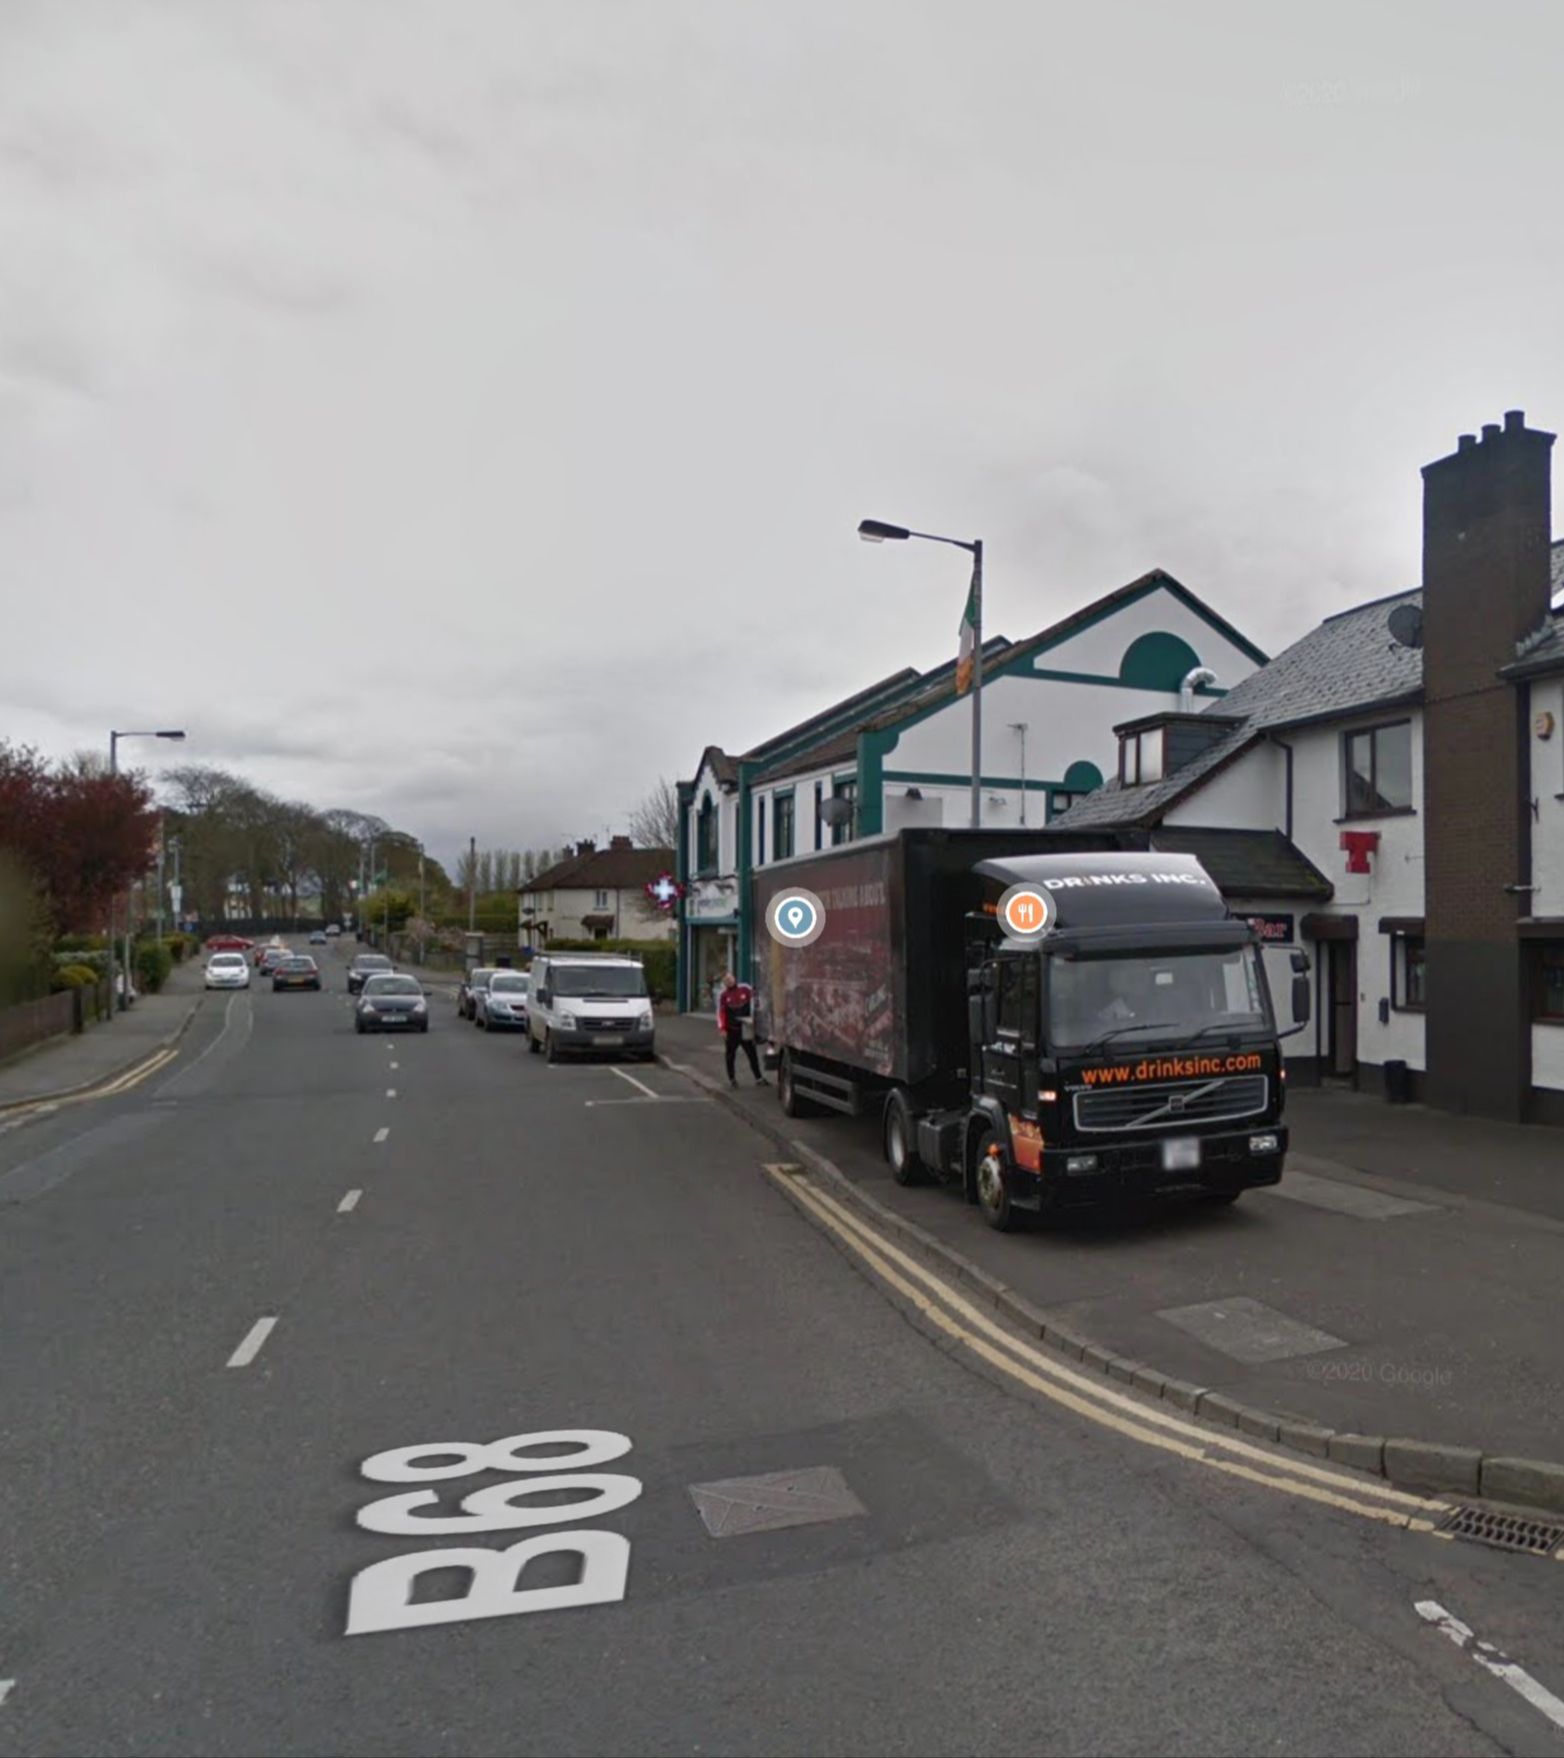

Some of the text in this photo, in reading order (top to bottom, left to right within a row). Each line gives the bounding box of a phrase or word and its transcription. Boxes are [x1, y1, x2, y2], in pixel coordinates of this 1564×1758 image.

[1042, 873, 1206, 890] DRINKS INC.
[1081, 1053, 1262, 1084] www.drinksinc.com
